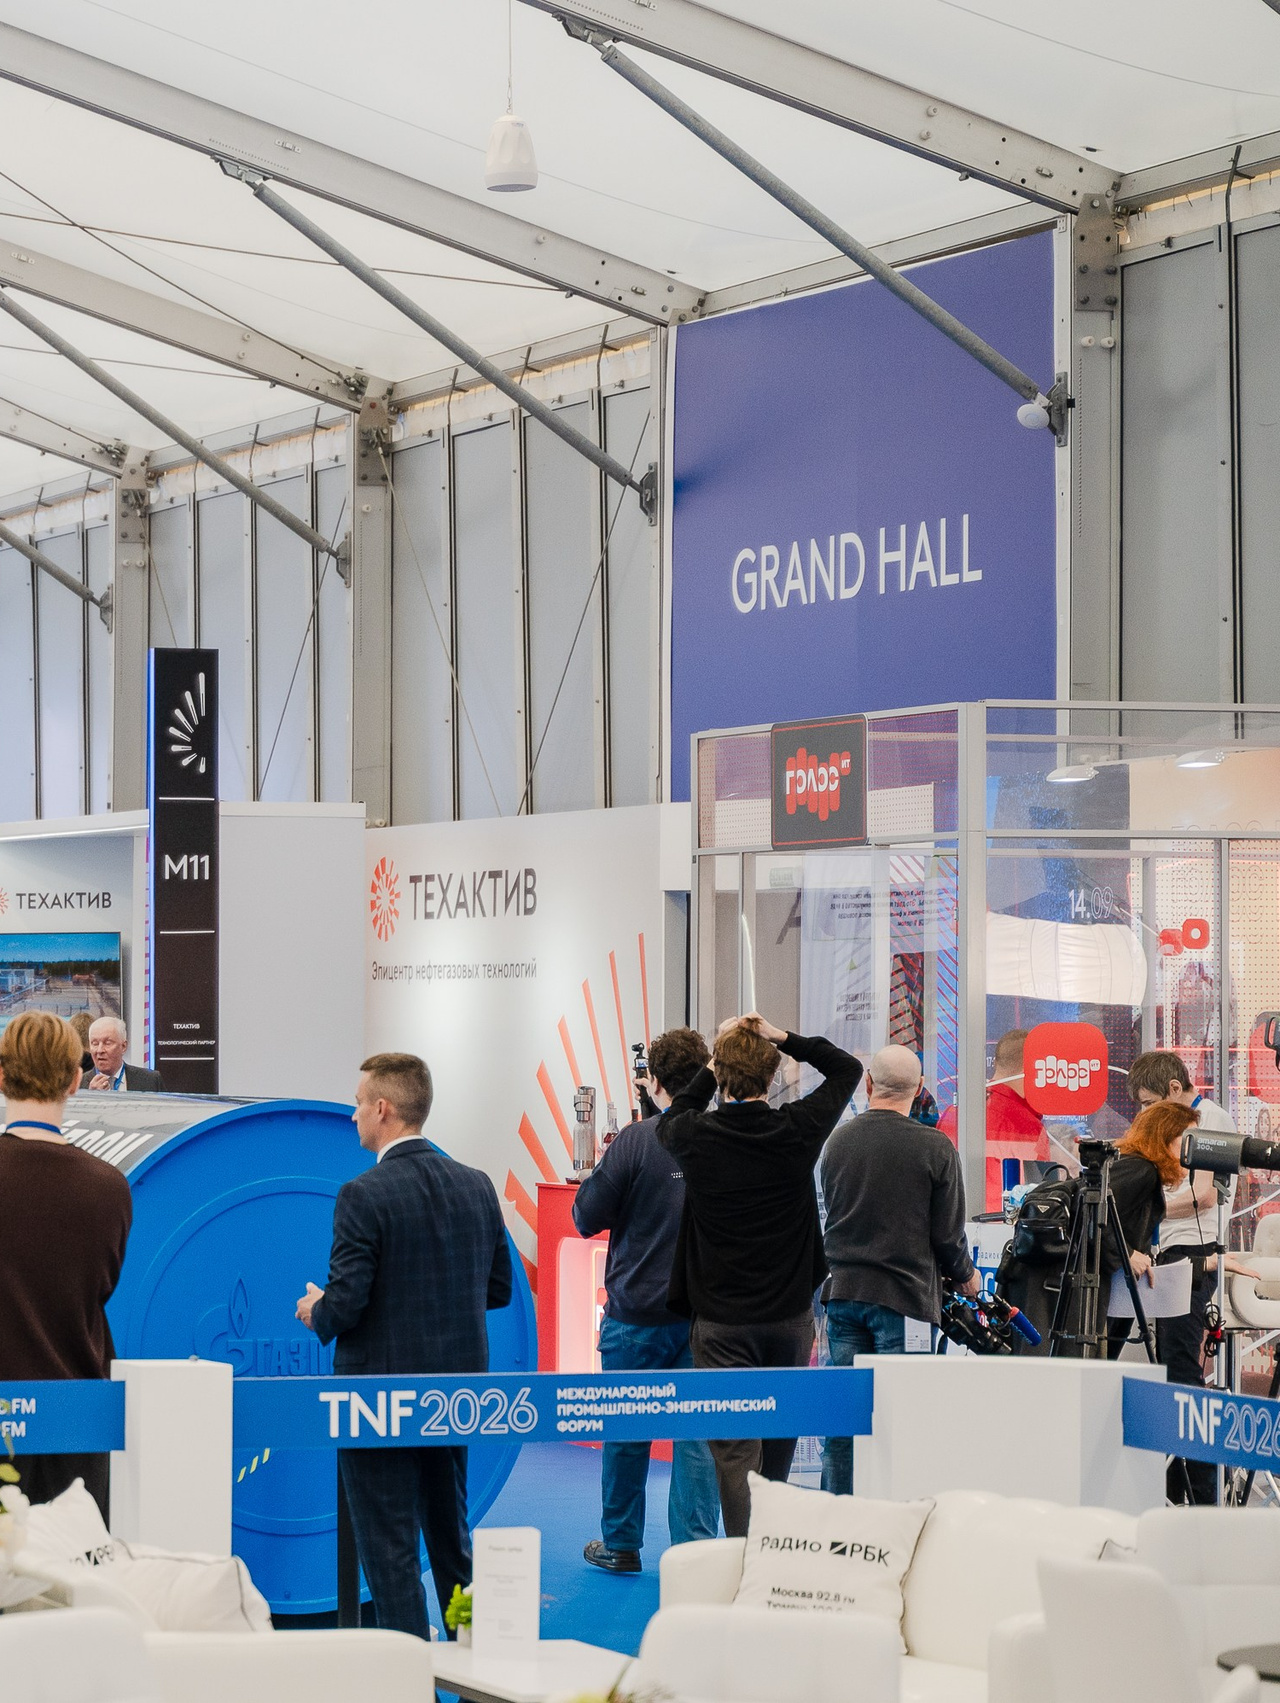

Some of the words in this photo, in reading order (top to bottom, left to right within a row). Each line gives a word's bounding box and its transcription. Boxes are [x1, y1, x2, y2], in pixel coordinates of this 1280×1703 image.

[732, 531, 866, 613] GRAND
[880, 514, 982, 595] HALL
[164, 854, 210, 880] M11
[15, 891, 111, 911] ТЕХАКТИВ
[409, 867, 538, 920] ТЕХАКТИВ
[1068, 885, 1114, 919] 14.09
[372, 960, 414, 985] Эпицентр
[416, 960, 480, 985] нефтегазовых
[482, 957, 537, 981] технологий
[1197, 1137, 1227, 1147] amaran
[556, 1382, 676, 1401] МЕЖДУНАРОДНЫЙ
[11, 1398, 37, 1415] FM
[320, 1390, 417, 1438] TNF
[420, 1386, 539, 1437] 2026
[556, 1396, 777, 1416] ПРОМЫШЛЕННО-ЭНЕРГЕТИЧЕСКИЙ
[1, 1420, 26, 1438] FM
[556, 1419, 604, 1434] ФОРУМ
[1174, 1391, 1223, 1446] TNF
[850, 1542, 891, 1567] РБК
[771, 1587, 813, 1599] Москва
